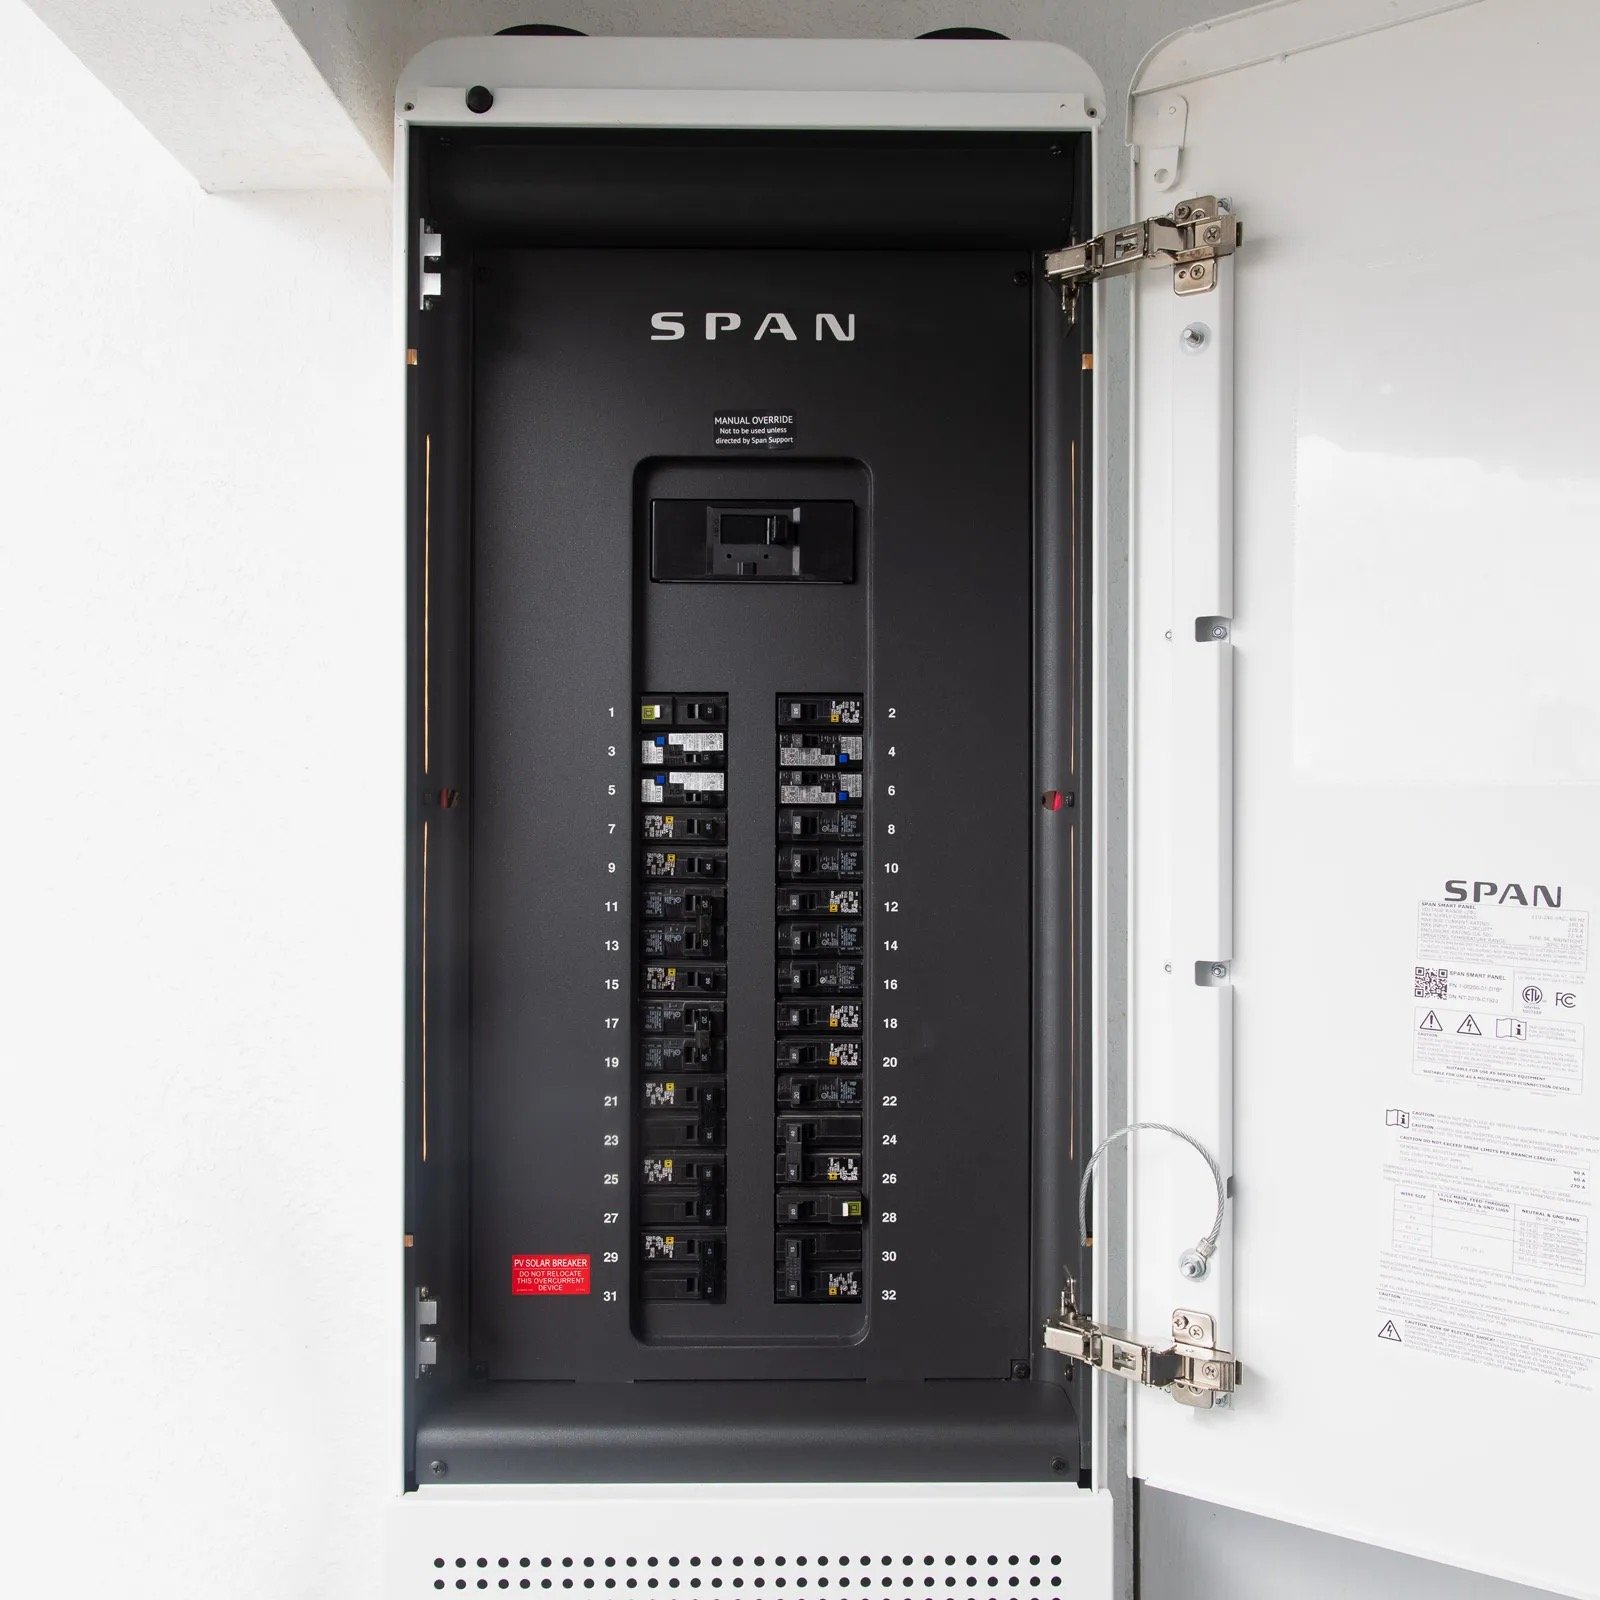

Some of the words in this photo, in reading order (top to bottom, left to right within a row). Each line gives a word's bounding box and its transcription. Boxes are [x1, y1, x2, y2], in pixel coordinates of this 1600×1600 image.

[650, 312, 856, 342] SPAN
[752, 416, 793, 424] OVERRIDE
[608, 706, 614, 718] 1
[888, 707, 896, 719] 2
[607, 745, 616, 757] 3
[887, 746, 896, 757] 4
[607, 784, 616, 796] 5
[887, 785, 896, 796] 6
[607, 823, 616, 835] 7
[887, 823, 896, 835] 8
[607, 862, 616, 874] 9
[884, 862, 899, 874] 10
[1445, 880, 1561, 907] SPAN
[604, 901, 618, 912] 11
[883, 901, 899, 912] 12
[604, 940, 620, 951] 13
[883, 940, 899, 951] 14
[604, 978, 620, 990] 15
[883, 979, 898, 990] 16
[604, 1017, 620, 1029] 17
[883, 1018, 898, 1029] 18
[604, 1056, 620, 1068] 19
[882, 1056, 898, 1068] 20
[604, 1095, 618, 1107] 21
[882, 1095, 898, 1107] 22
[604, 1134, 619, 1146] 23
[882, 1134, 898, 1145] 24
[603, 1173, 619, 1185] 25
[882, 1173, 897, 1185] 26
[603, 1212, 619, 1224] 27
[882, 1212, 897, 1223] 28
[603, 1251, 619, 1263] 29
[881, 1250, 897, 1262] 30
[603, 1290, 617, 1302] 31
[881, 1289, 897, 1301] 32
[1451, 1329, 1475, 1338] ELECTRIC
